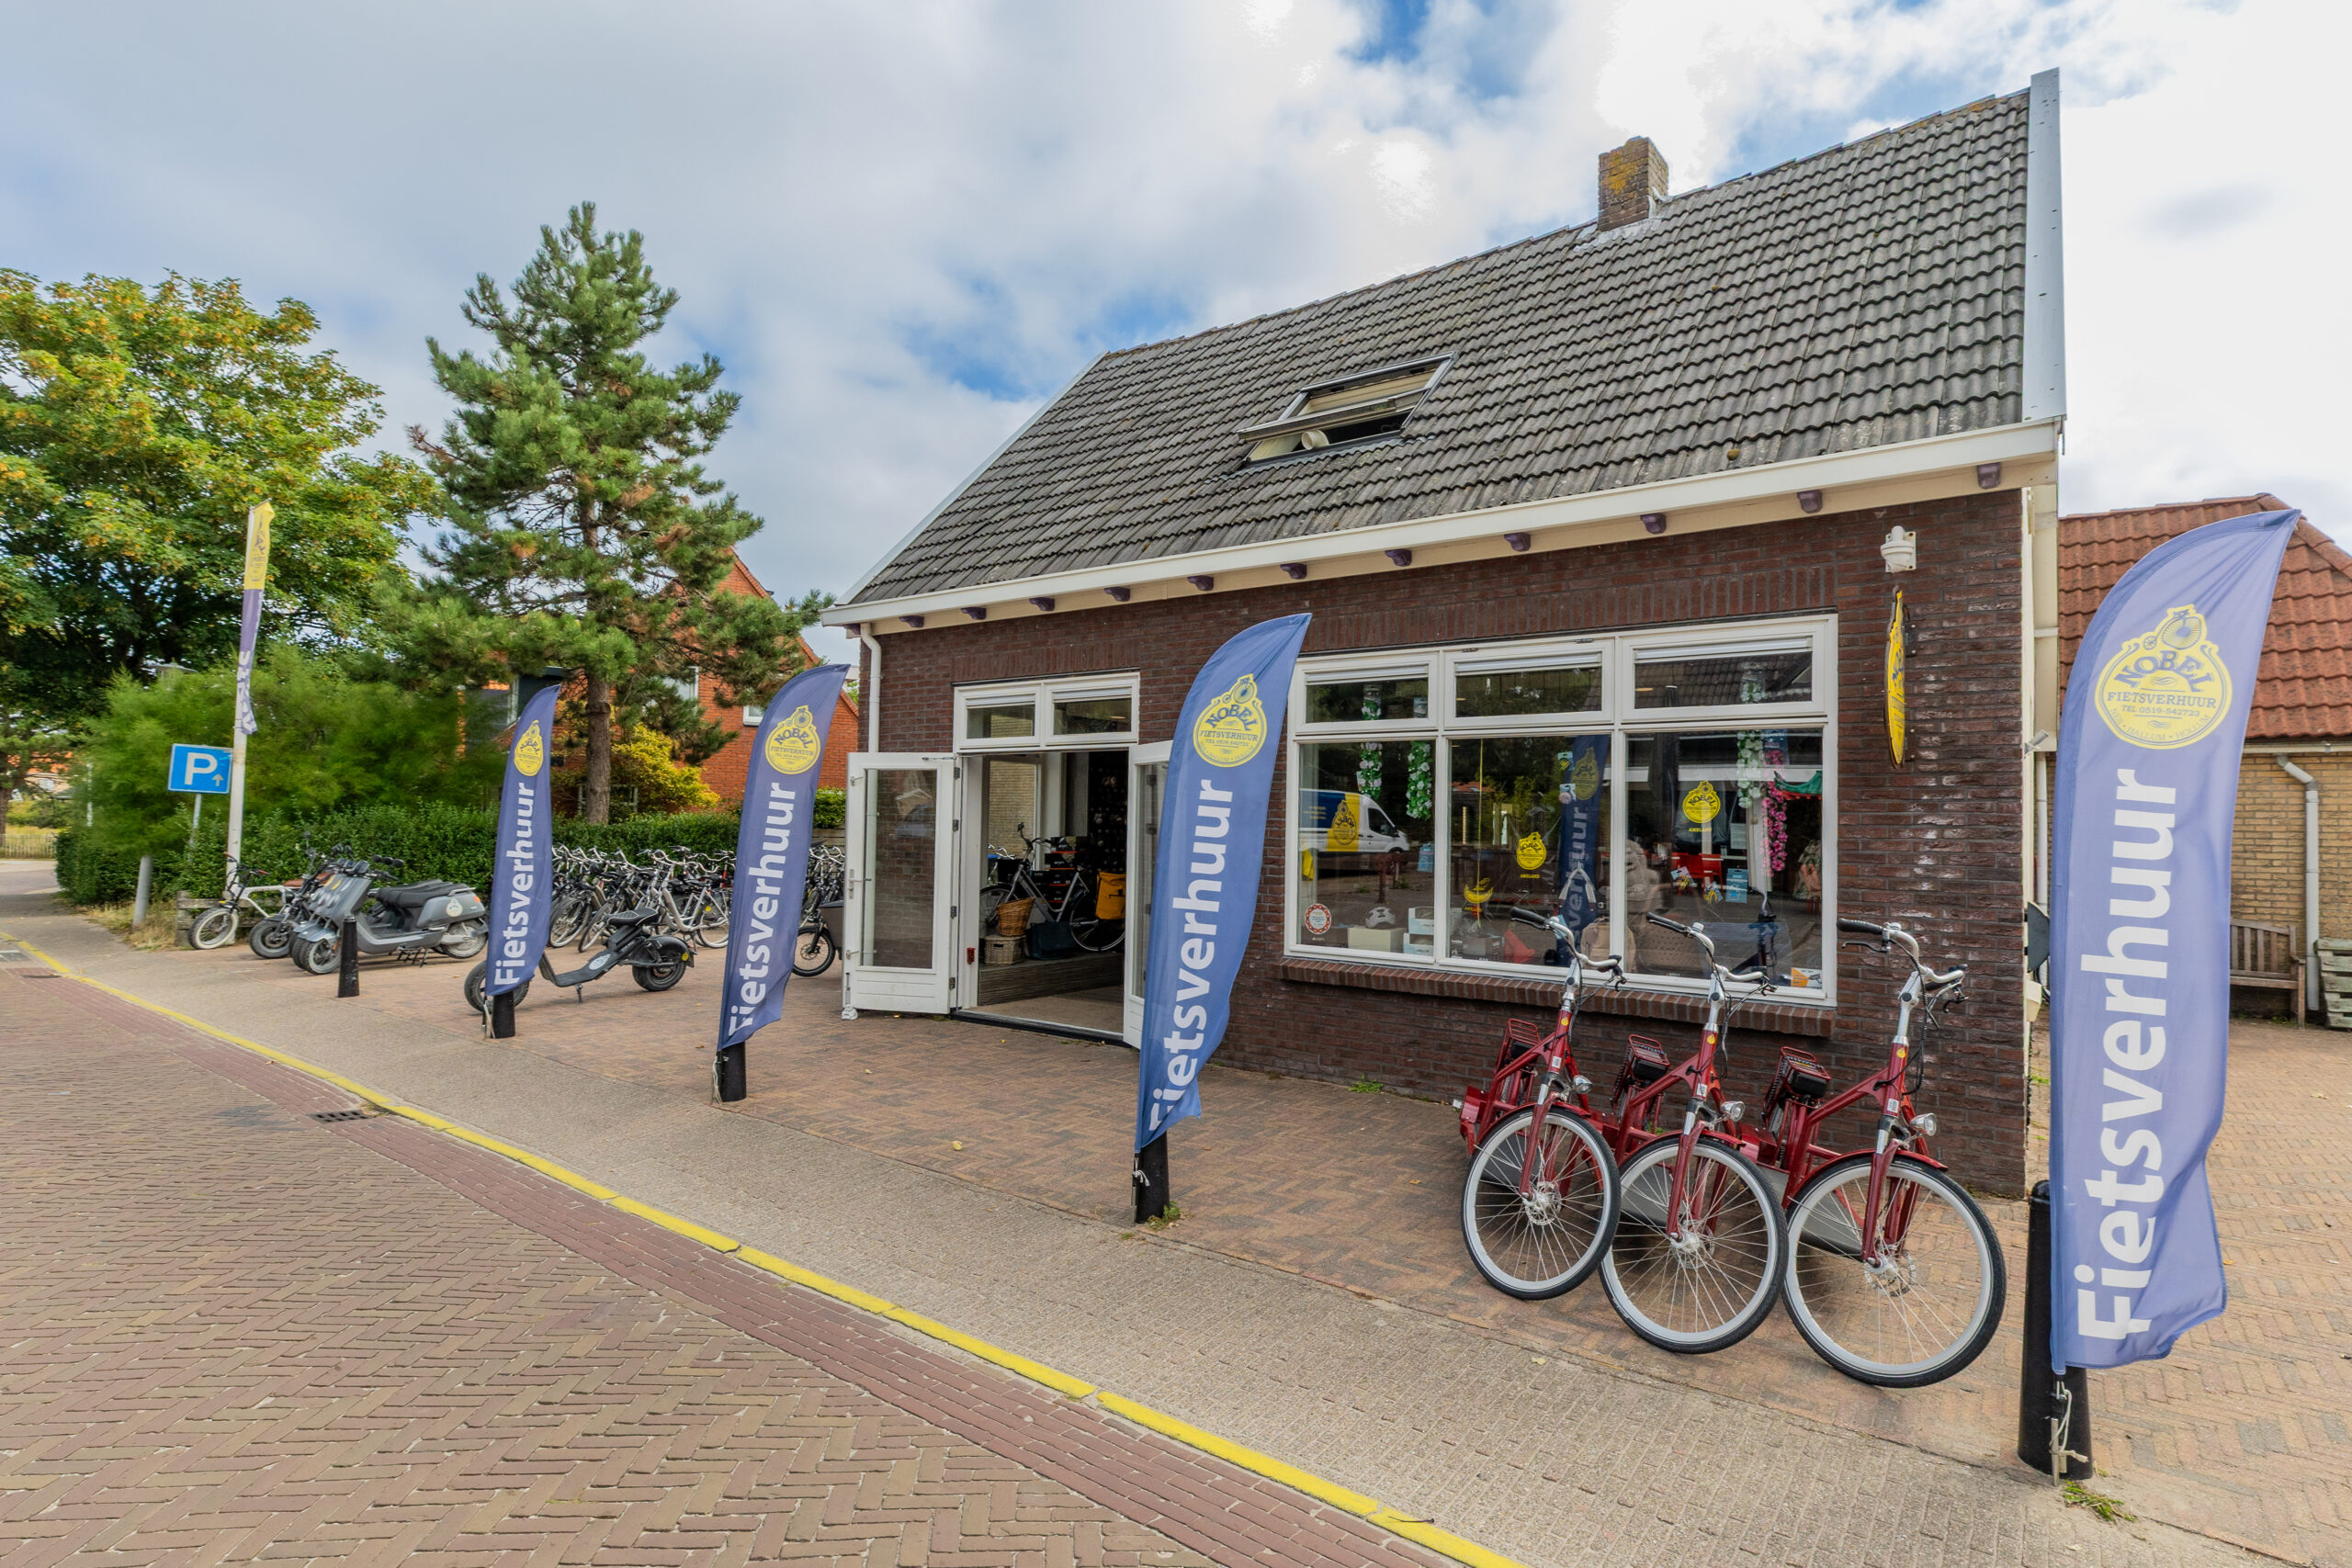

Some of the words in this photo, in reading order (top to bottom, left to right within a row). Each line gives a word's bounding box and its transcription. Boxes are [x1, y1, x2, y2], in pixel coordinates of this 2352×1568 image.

[2114, 650, 2214, 693] NOBEL
[2107, 692, 2217, 709] FIETSVERHUUR
[2121, 705, 2138, 714] TEL
[2139, 706, 2200, 717] 0519-542723
[1204, 704, 1258, 731] NOBEL
[2127, 728, 2166, 741] BALLUM
[2175, 715, 2211, 740] HOLLUM
[774, 728, 814, 749] NOBEL
[1199, 730, 1259, 742] FIETSVERHUUR
[184, 751, 219, 785] P
[493, 782, 535, 986] Fietsverhuur
[2074, 768, 2177, 1341] Fietsverhuur
